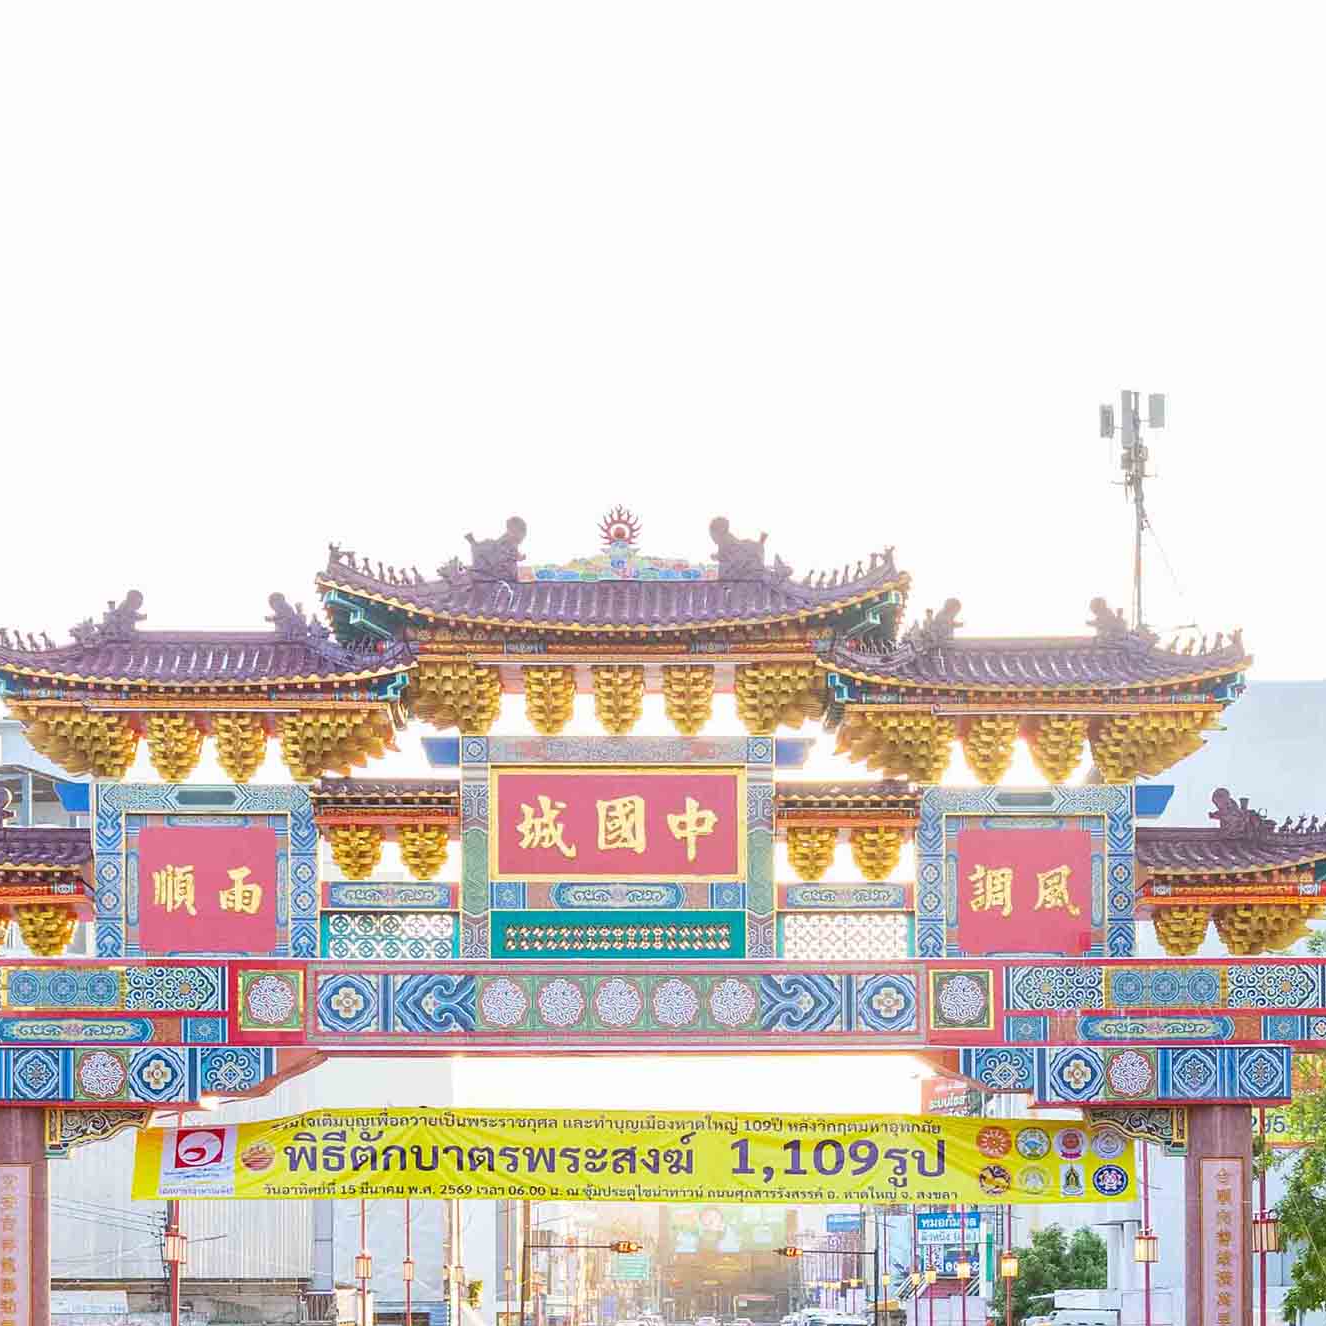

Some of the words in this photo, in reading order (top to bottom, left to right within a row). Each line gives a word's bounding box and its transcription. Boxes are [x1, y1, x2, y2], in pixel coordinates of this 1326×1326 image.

[284, 1131, 696, 1174] พิธีตักบาตรพระสงฆ์
[264, 1180, 337, 1195] วันอาทิตย์ที่
[341, 1184, 356, 1195] 15
[361, 1181, 404, 1195] มีนาคม
[408, 1184, 435, 1195] พ.ศ.
[440, 1184, 472, 1195] 2569
[476, 1185, 505, 1196] เวลา
[509, 1185, 545, 1196] 06.00
[917, 1189, 957, 1200] สงขลา
